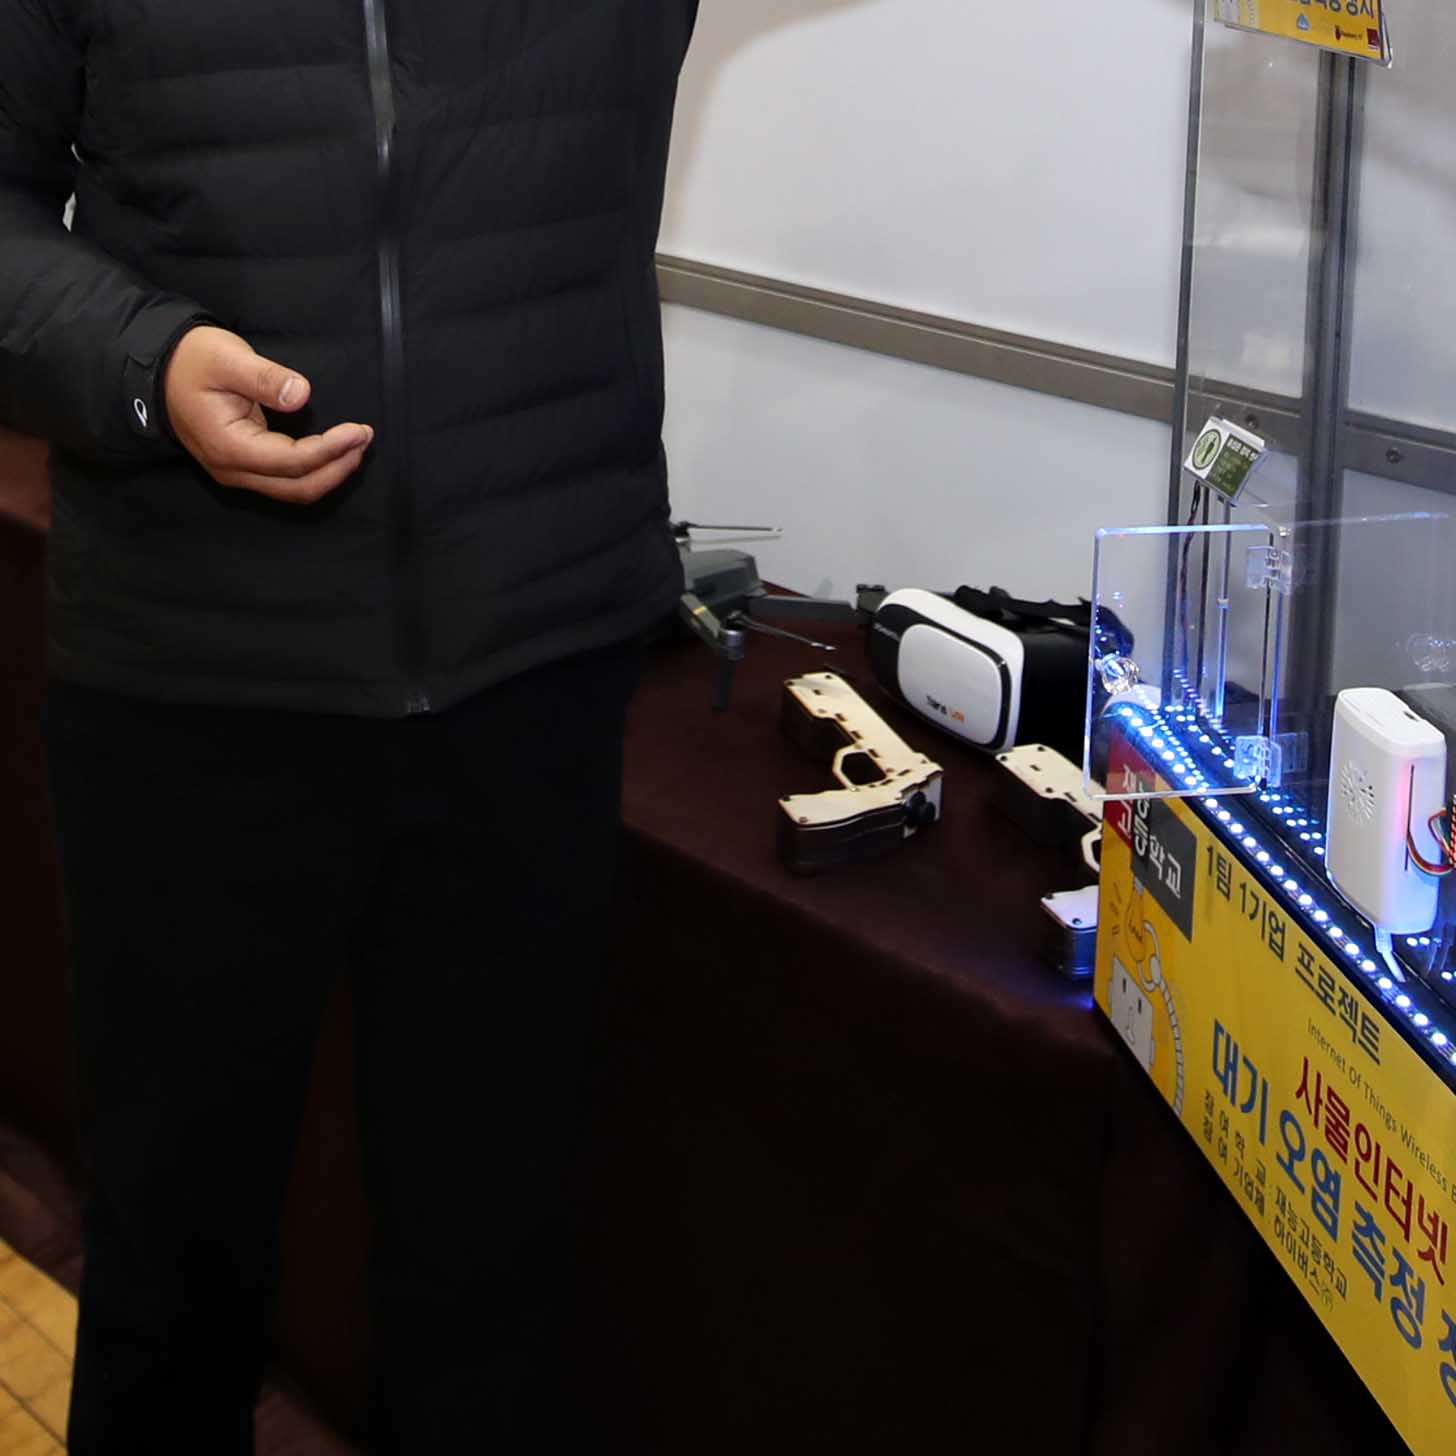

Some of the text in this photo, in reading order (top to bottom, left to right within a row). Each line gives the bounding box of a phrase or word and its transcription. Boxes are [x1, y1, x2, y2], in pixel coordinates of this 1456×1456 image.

[1206, 844, 1381, 1066] 1팀 1기업 프로젝트
[1212, 1017, 1270, 1147] 대기
[1276, 1109, 1343, 1244] 오염
[1351, 1200, 1426, 1351] 측정
[1295, 1055, 1449, 1287] 사물인터넷
[1307, 1018, 1346, 1074] Internet
[1348, 1066, 1363, 1089] Of
[1363, 1080, 1397, 1132] Things
[1399, 1123, 1448, 1193] Wireless
